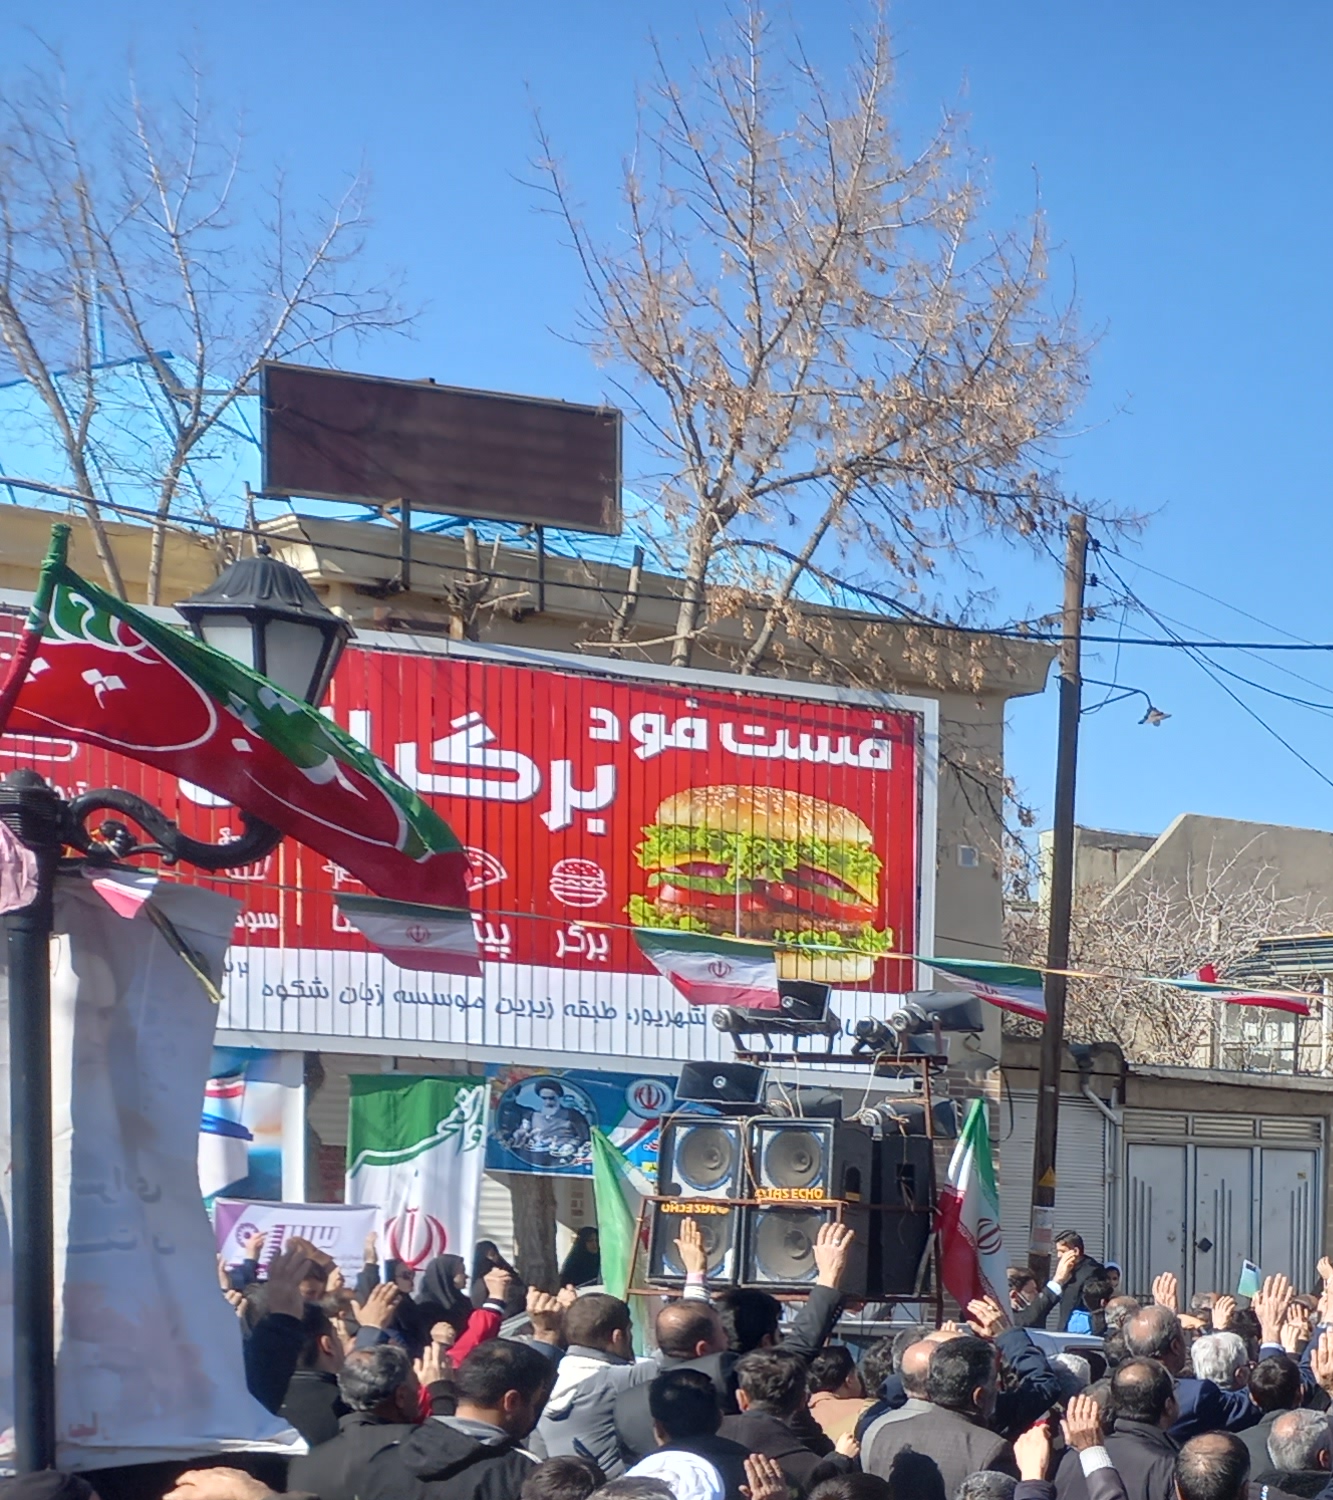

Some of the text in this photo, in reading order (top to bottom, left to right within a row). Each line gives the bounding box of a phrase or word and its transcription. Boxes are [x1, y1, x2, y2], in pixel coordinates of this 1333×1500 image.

[588, 699, 894, 770] فست فود
[261, 976, 330, 1003] شکوه
[339, 982, 384, 1007] زبان
[392, 988, 486, 1013] موسسه
[563, 1000, 618, 1024] طبقه
[791, 1187, 824, 1199] ECHO
